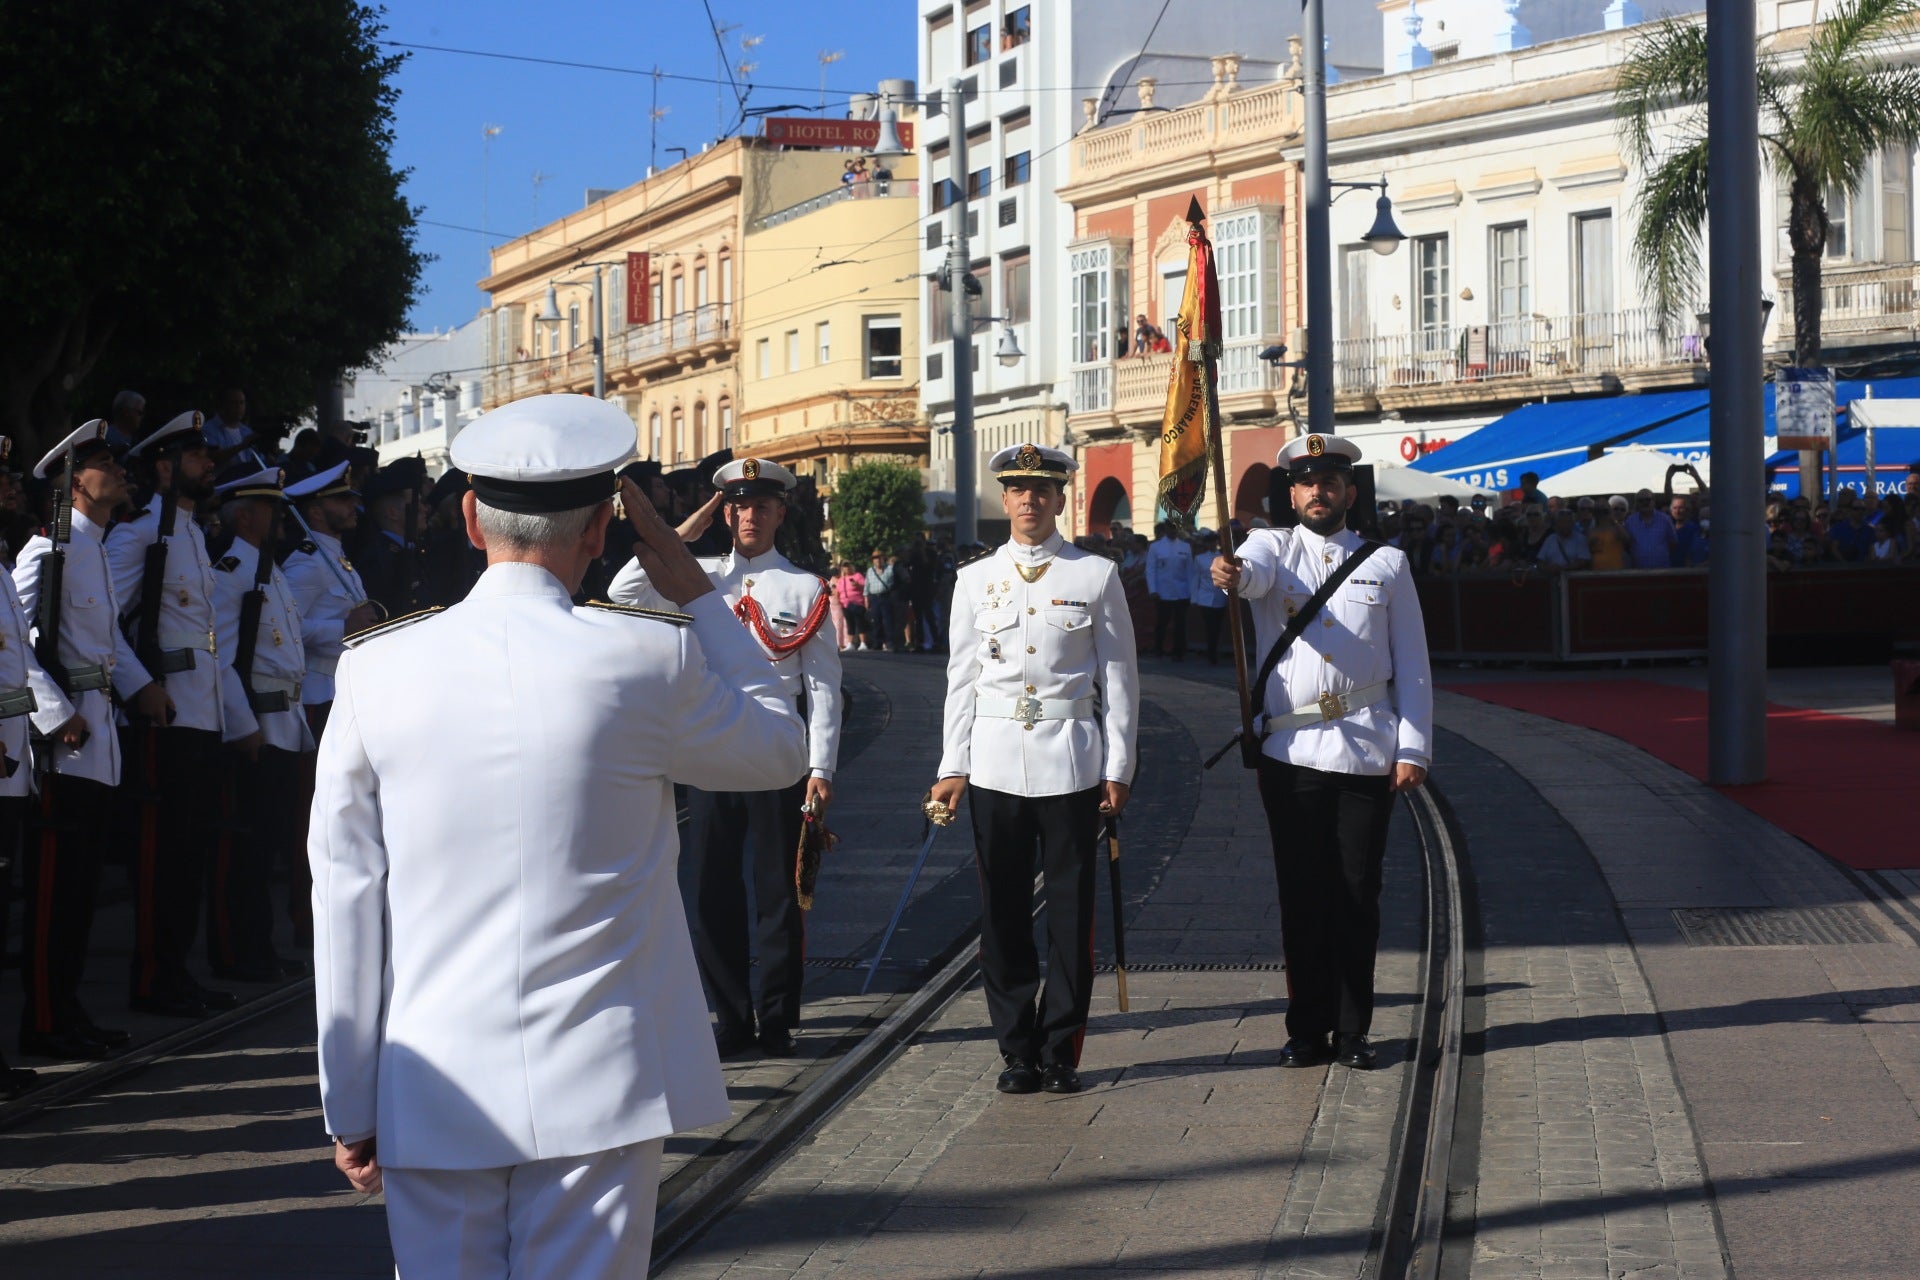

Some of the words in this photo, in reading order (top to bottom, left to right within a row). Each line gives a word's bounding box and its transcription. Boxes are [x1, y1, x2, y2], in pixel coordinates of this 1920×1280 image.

[789, 125, 845, 140] HOTEL
[853, 127, 880, 141] RO
[632, 256, 645, 319] HOTEL
[1163, 379, 1203, 444] DESEMBARCO
[1875, 481, 1907, 494] RAC
